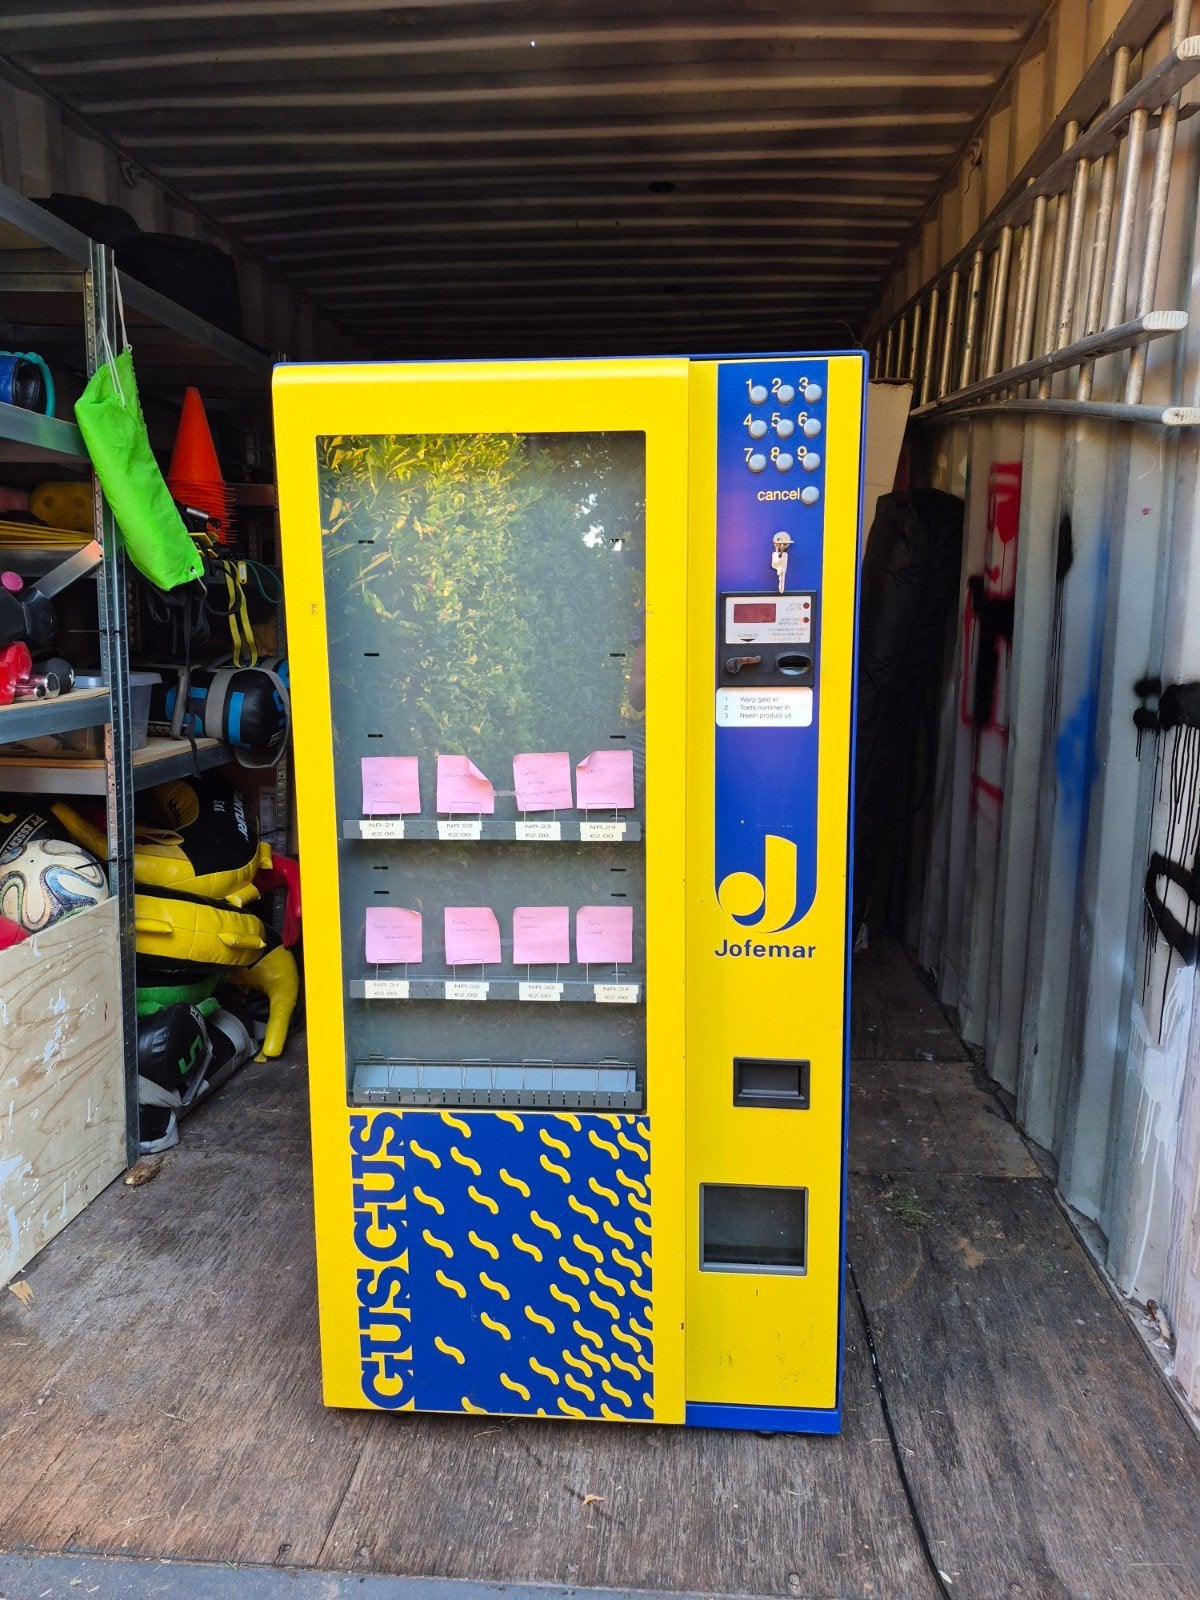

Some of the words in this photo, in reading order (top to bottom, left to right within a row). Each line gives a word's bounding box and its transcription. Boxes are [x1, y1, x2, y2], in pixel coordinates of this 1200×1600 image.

[745, 379, 752, 394] 1
[771, 378, 782, 393] 2
[798, 377, 809, 392] 3
[743, 413, 752, 426] 4
[771, 412, 781, 427] 5
[797, 412, 808, 427] 6
[743, 447, 753, 462] 7
[770, 447, 780, 462] 8
[797, 446, 807, 461] 9
[757, 487, 800, 501] cancel
[757, 696, 771, 704] geld
[759, 712, 783, 720] product
[714, 938, 817, 959] Jofemar
